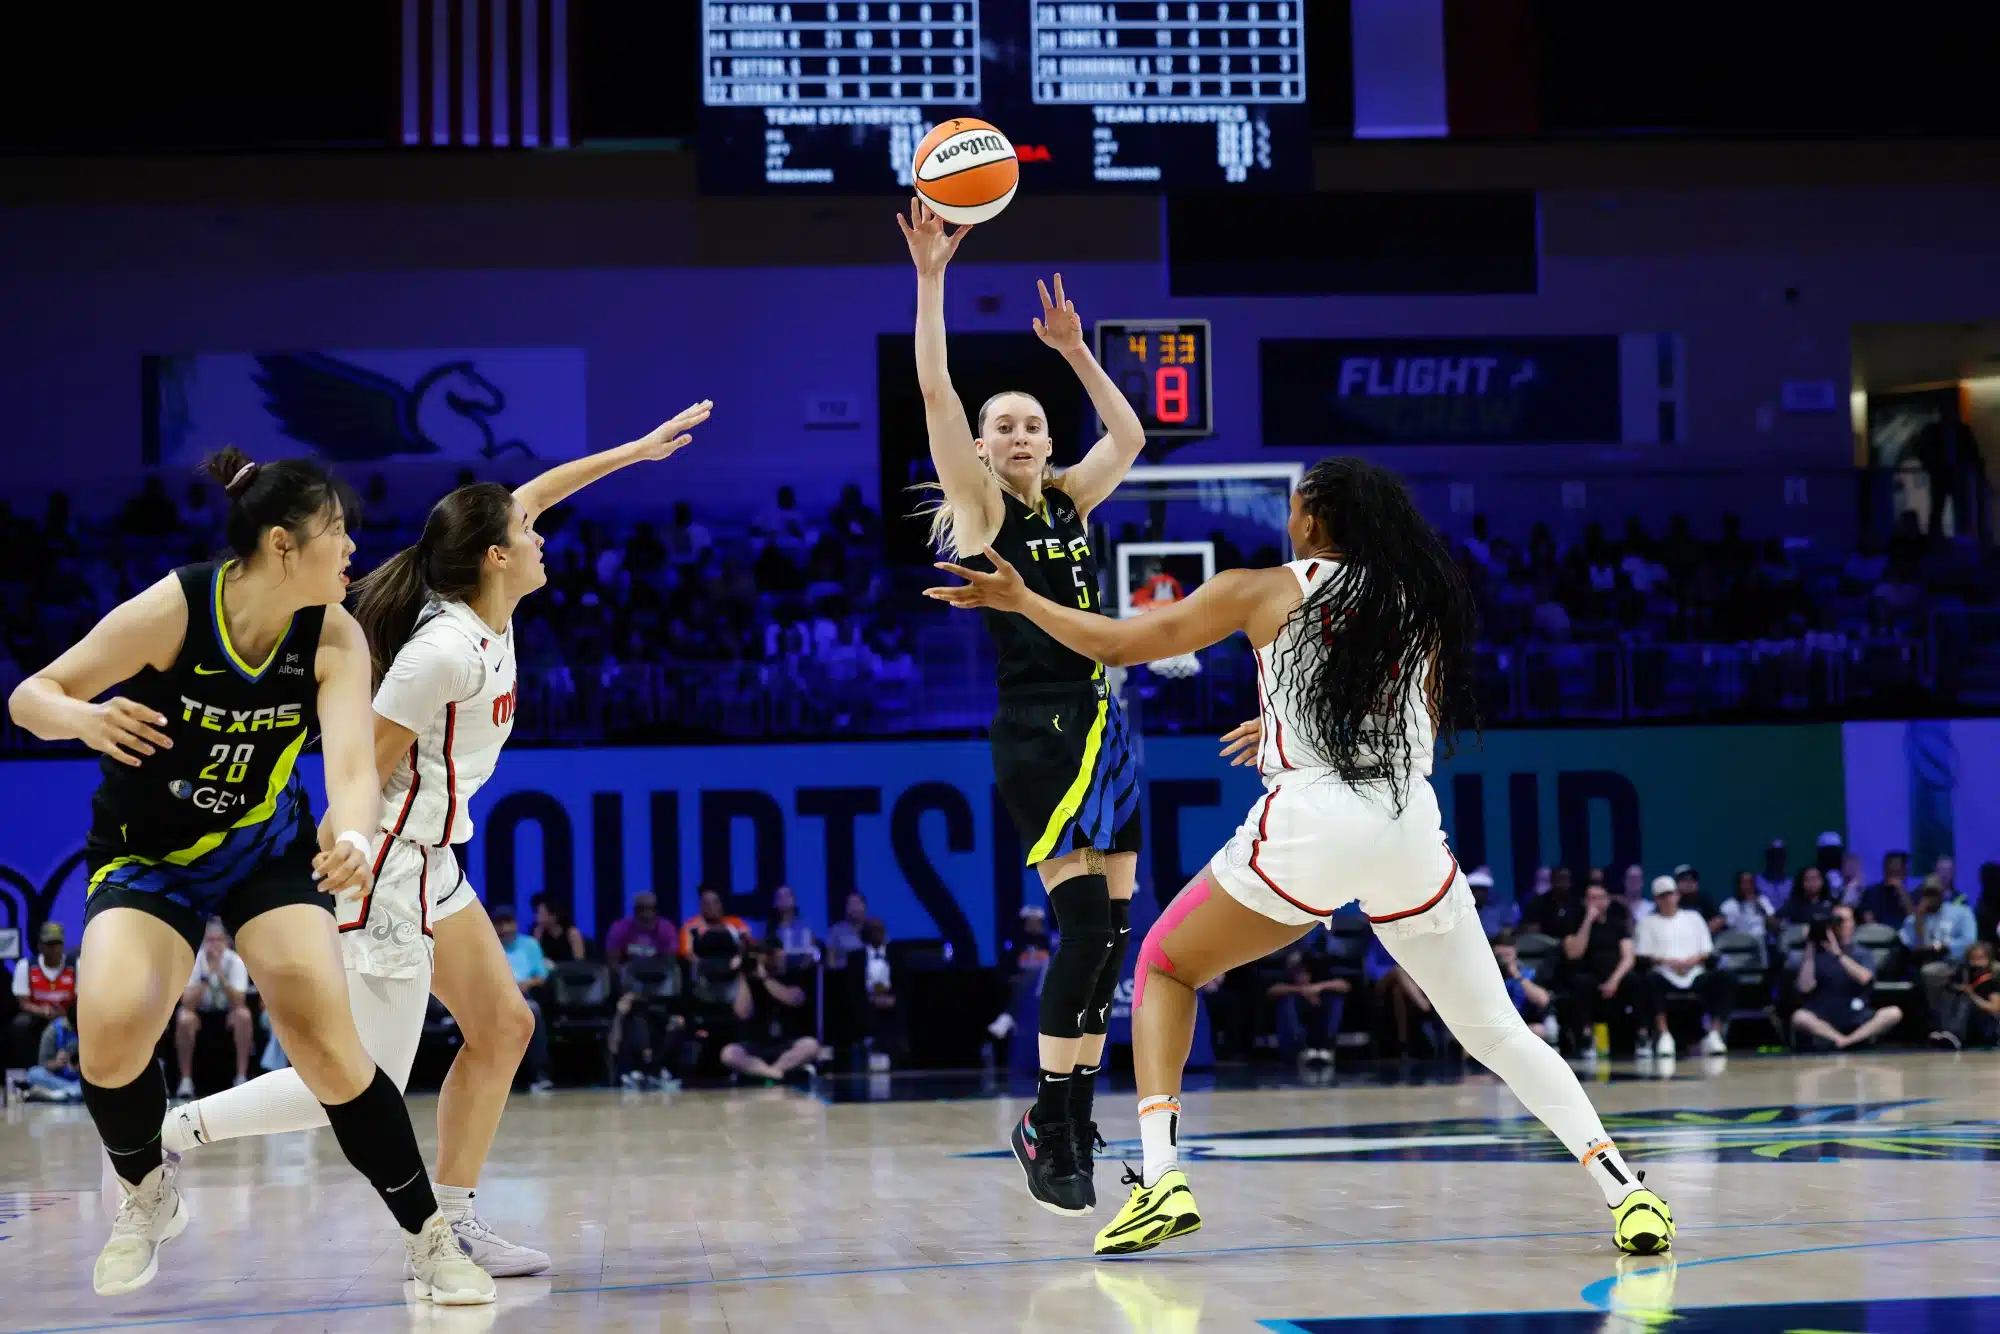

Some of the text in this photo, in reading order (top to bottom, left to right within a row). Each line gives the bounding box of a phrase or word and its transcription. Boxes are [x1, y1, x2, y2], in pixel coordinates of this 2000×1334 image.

[764, 106, 922, 125] TEAM STATISTICS
[1093, 104, 1248, 123] TEAM STATISTICS
[936, 135, 1004, 163] Wilson
[1128, 333, 1195, 364] 4 33
[1337, 356, 1498, 396] FLIGHT
[1156, 366, 1188, 423] 8
[1071, 565, 1091, 609] 5
[278, 664, 305, 677] Albert
[180, 694, 303, 734] TEXAS
[198, 743, 255, 783] 28
